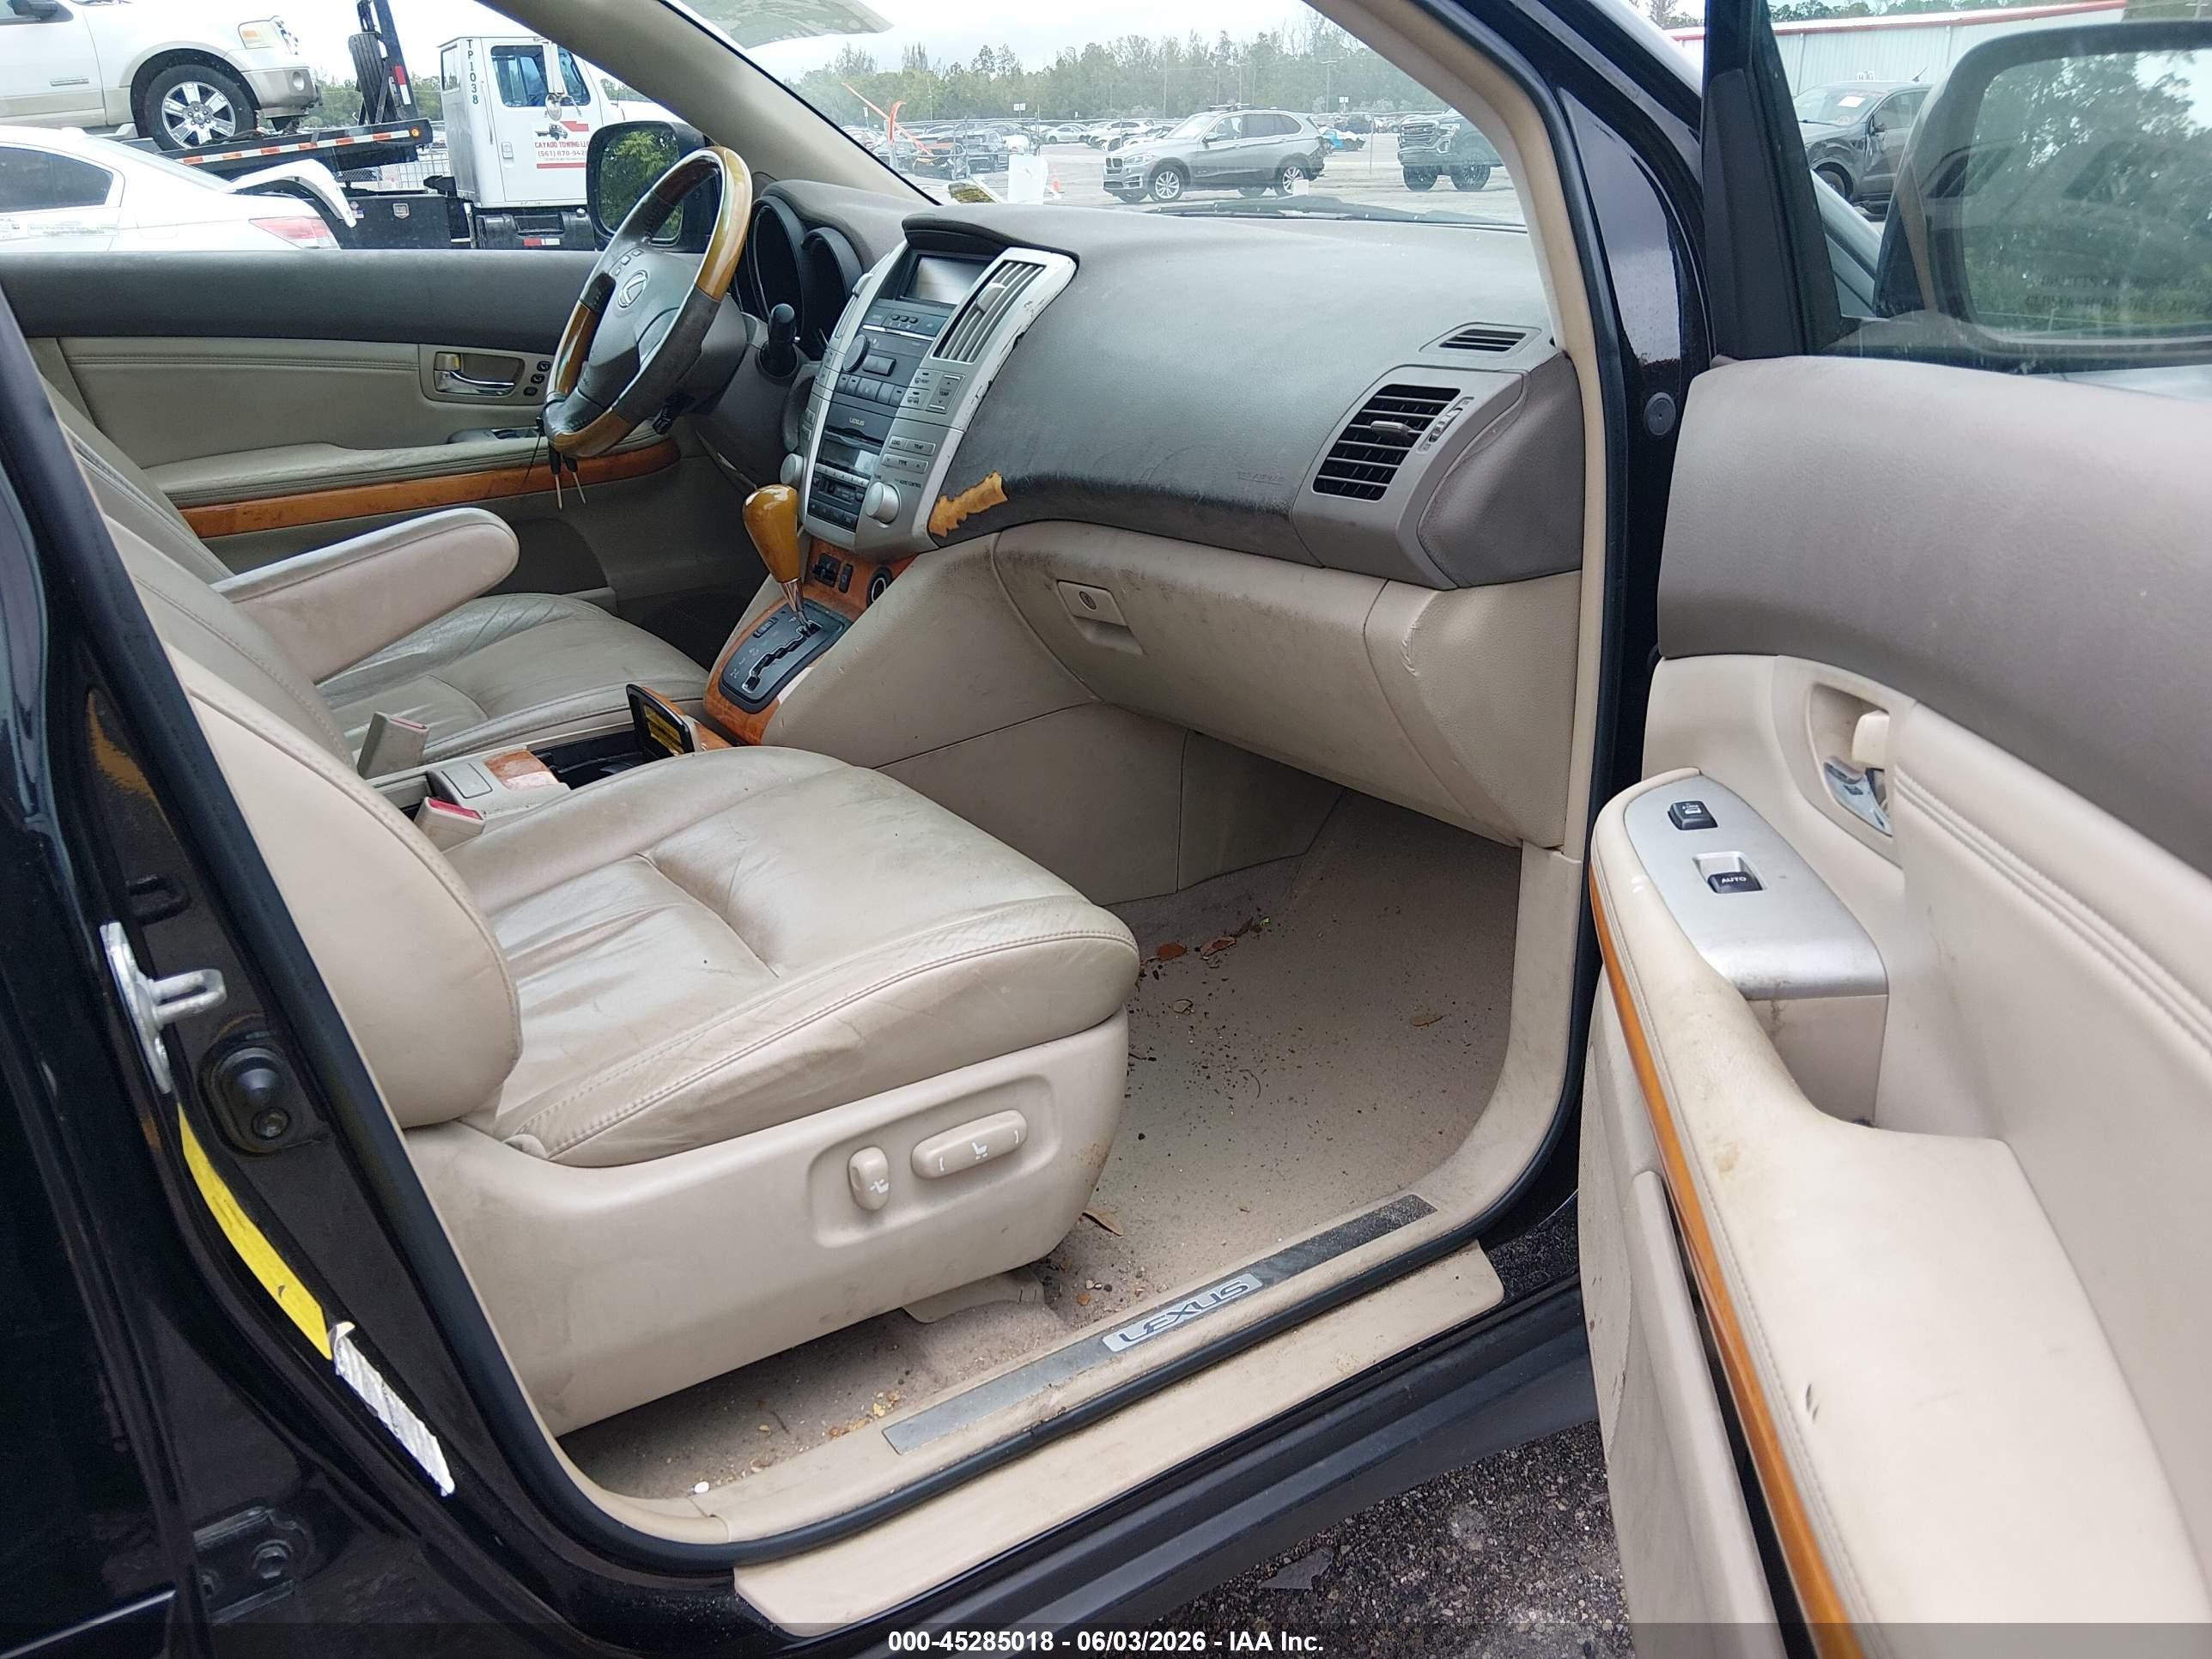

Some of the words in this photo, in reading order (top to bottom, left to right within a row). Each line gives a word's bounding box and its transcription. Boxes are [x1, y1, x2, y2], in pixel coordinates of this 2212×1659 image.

[466, 40, 478, 104] TP1038
[849, 416, 865, 426] LEXUS
[1118, 1279, 1249, 1342] LEXUS
